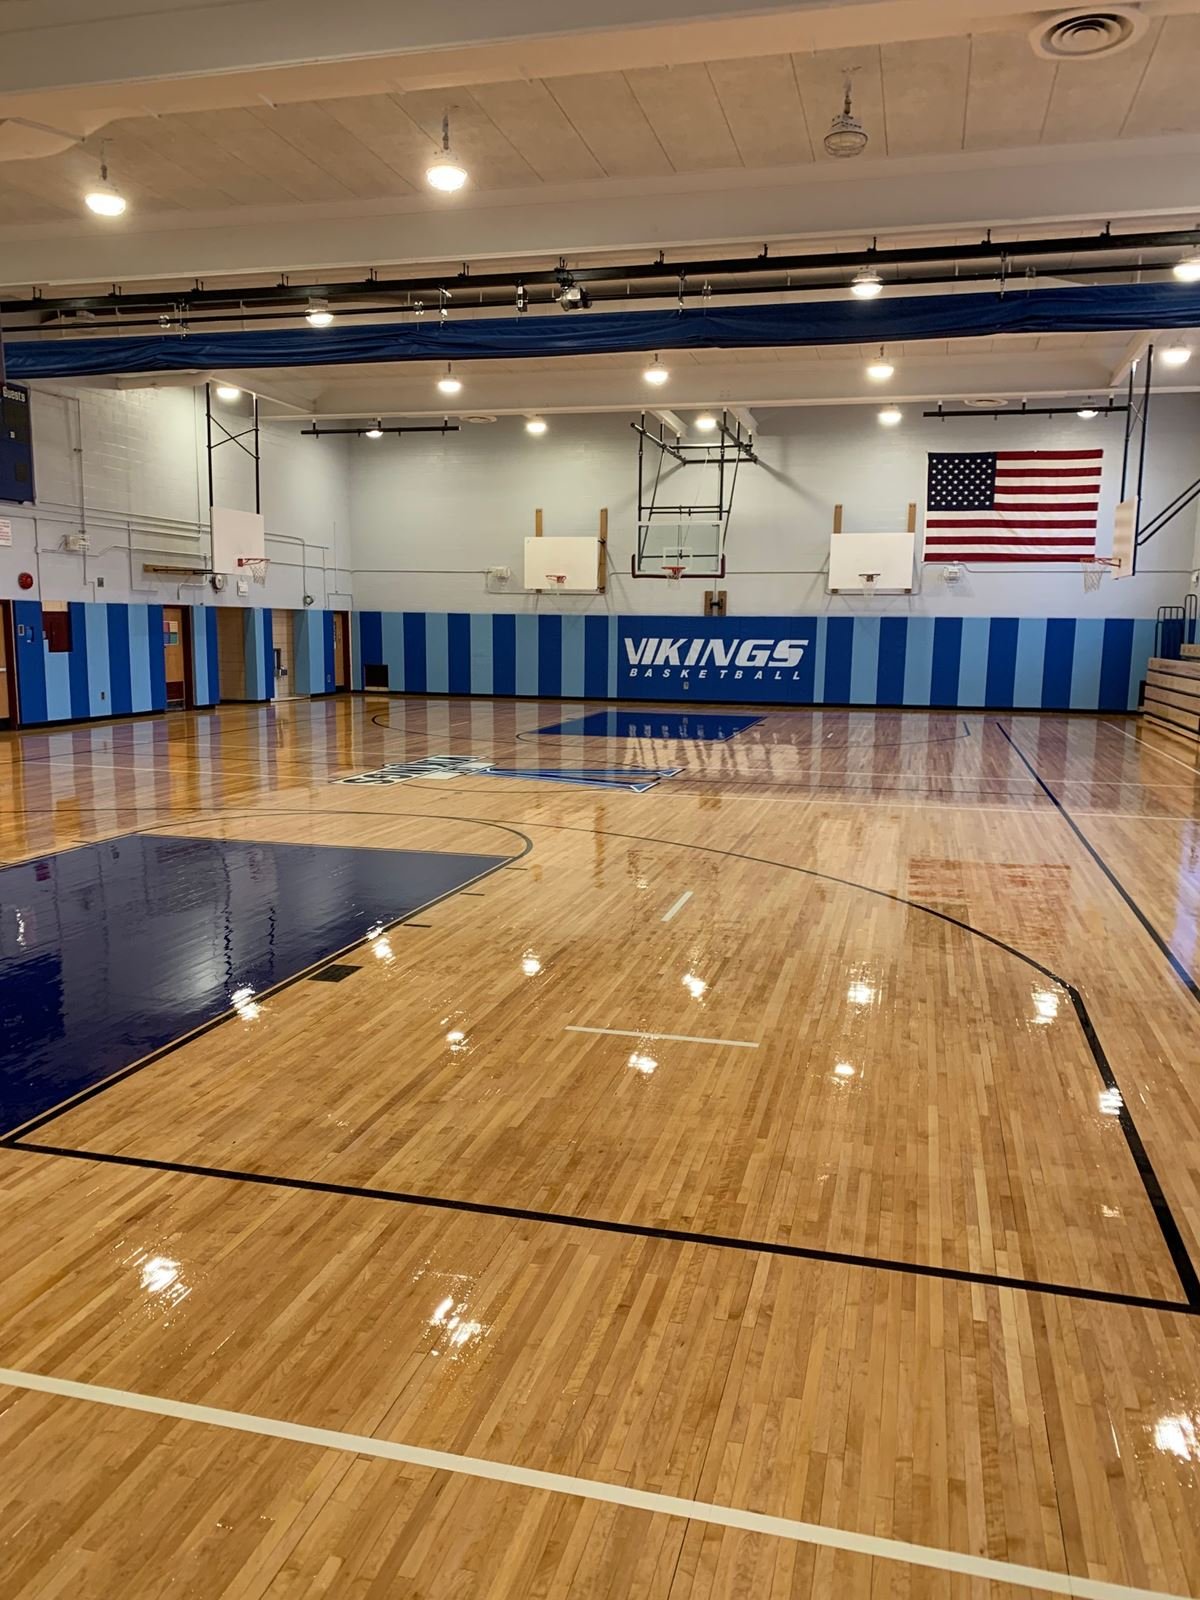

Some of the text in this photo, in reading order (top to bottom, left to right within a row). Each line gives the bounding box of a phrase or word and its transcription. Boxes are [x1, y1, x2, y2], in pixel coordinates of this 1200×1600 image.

[2, 386, 26, 402] Guests
[624, 638, 809, 668] VIKINGS
[629, 668, 801, 680] BASKETBALL
